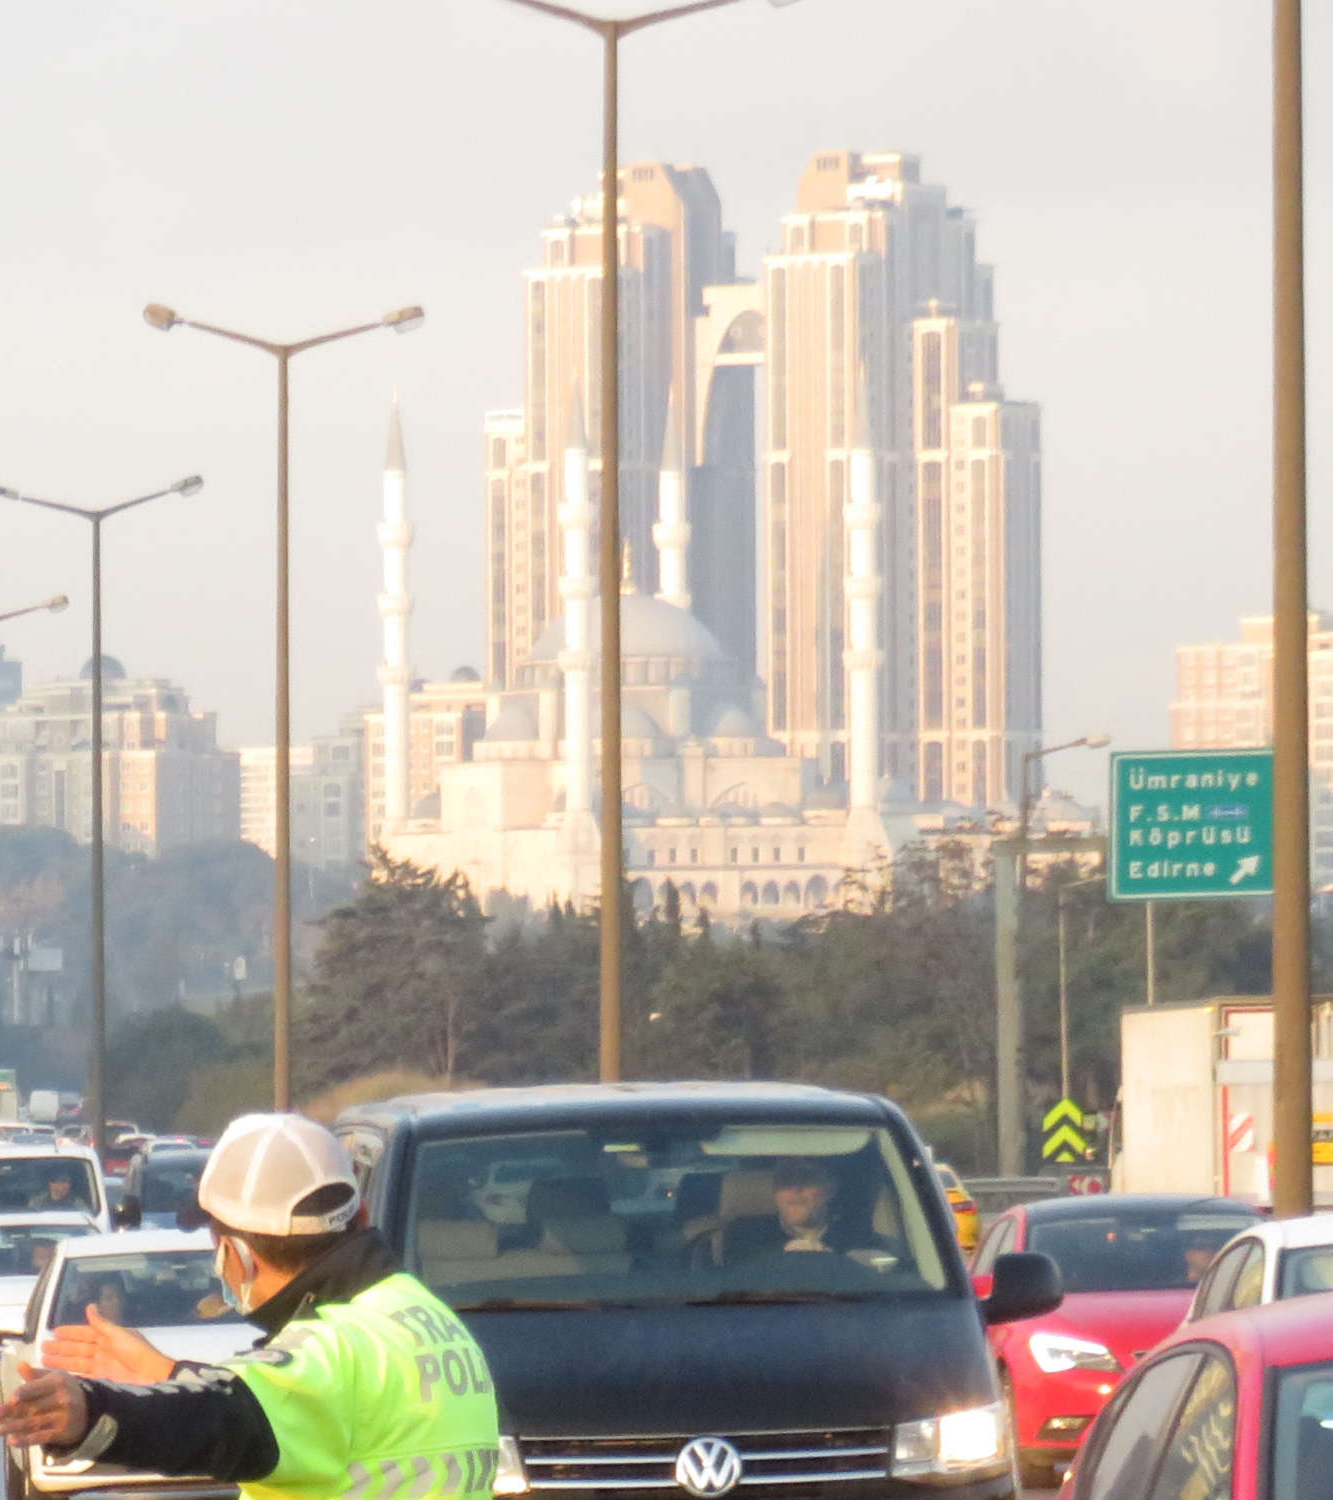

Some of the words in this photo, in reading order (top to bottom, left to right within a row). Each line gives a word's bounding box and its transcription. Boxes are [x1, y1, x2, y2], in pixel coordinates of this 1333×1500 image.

[1129, 767, 1259, 791] Ümraniye
[1129, 826, 1251, 849] Köprüsü
[1129, 861, 1217, 879] Edirne
